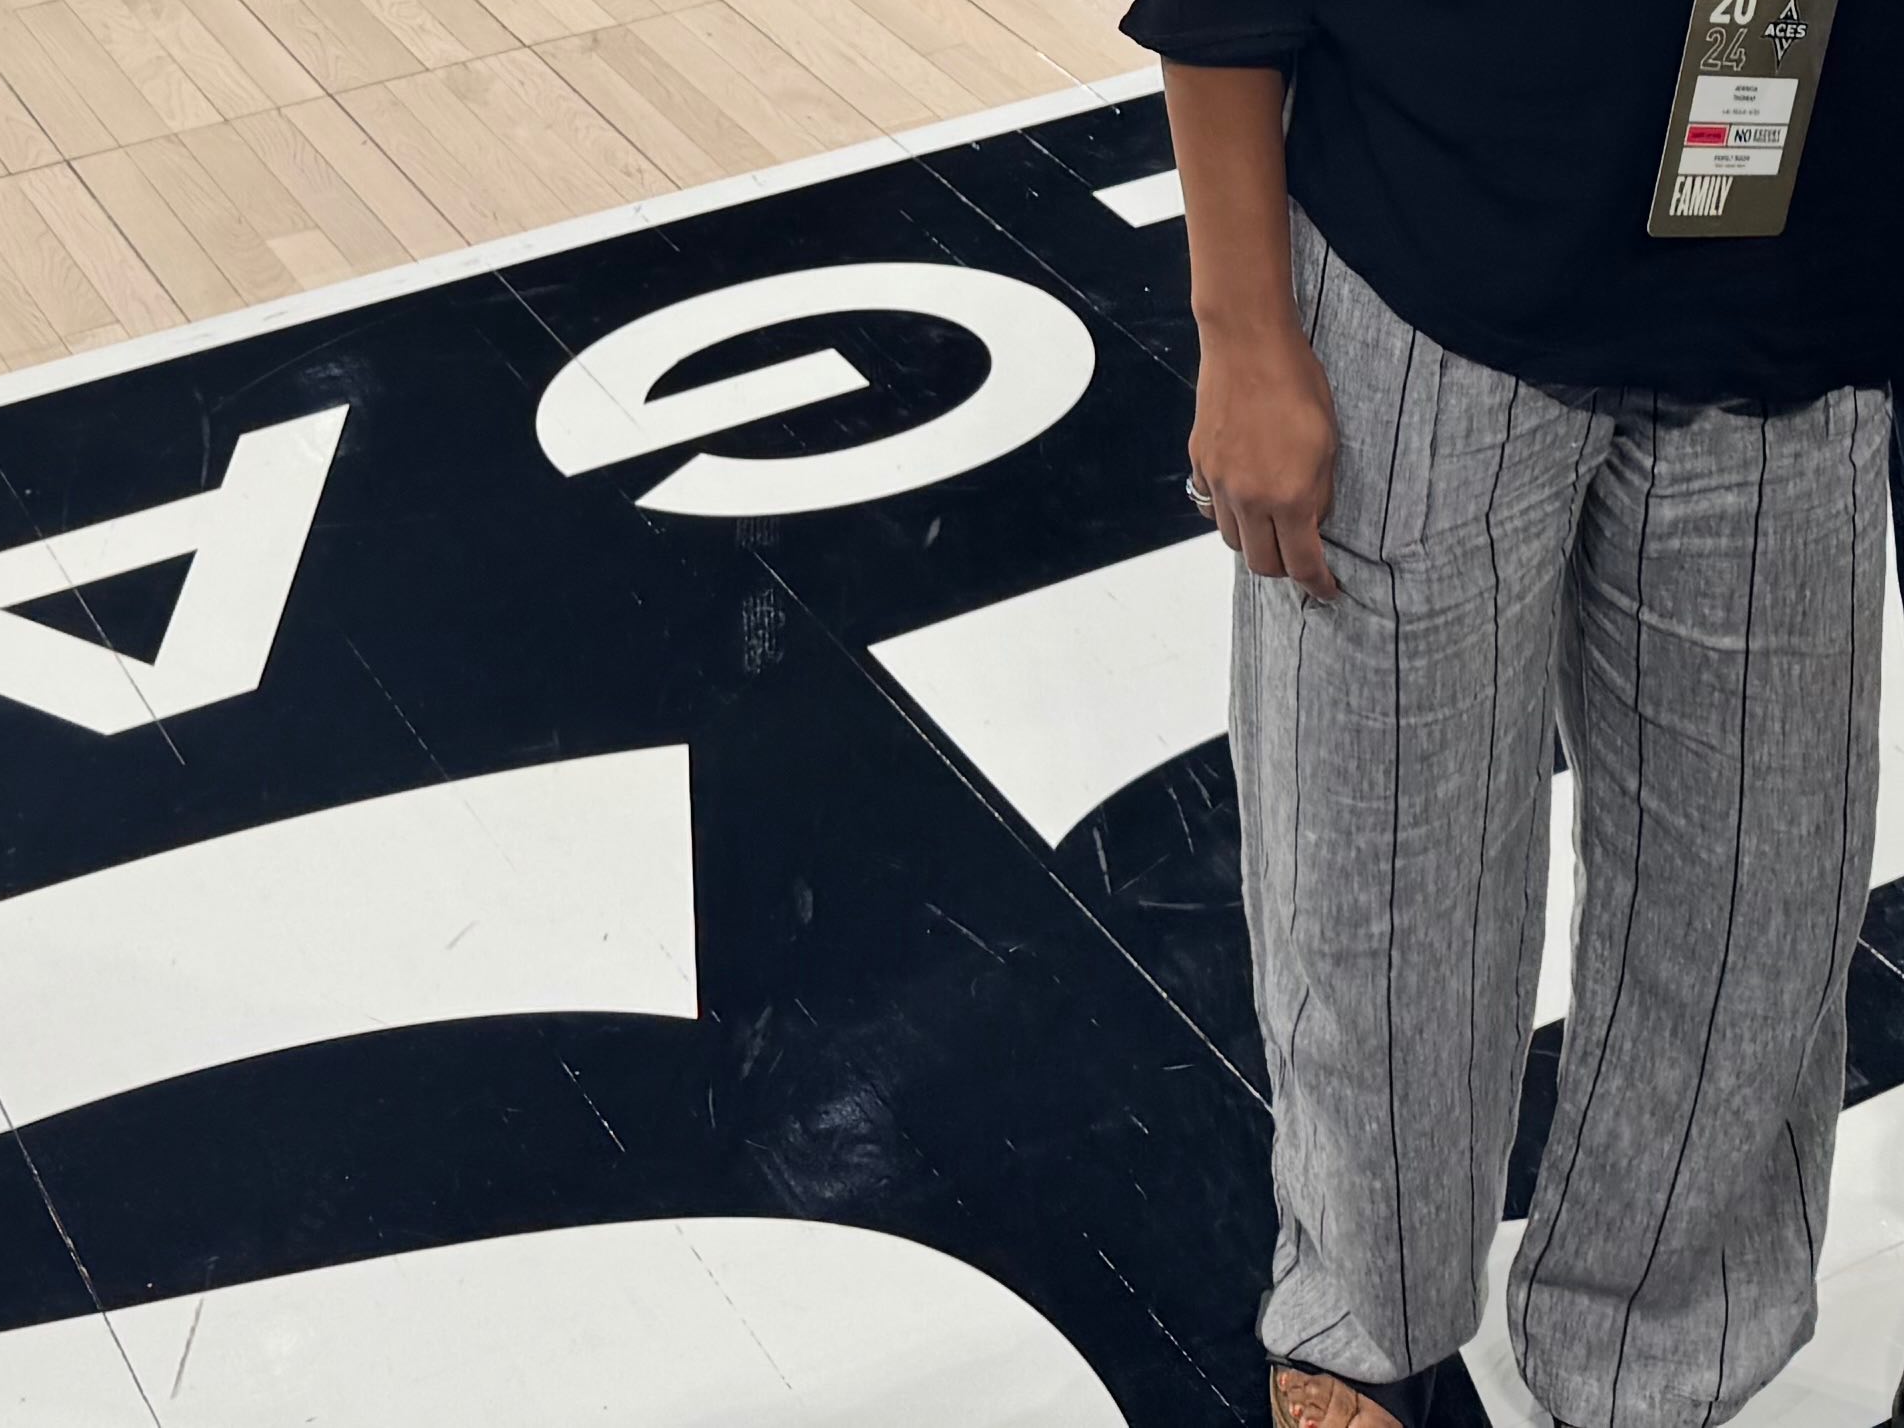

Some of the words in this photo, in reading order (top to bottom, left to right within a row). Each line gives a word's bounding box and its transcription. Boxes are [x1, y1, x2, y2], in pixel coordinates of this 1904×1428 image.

[1763, 23, 1808, 38] ACES
[1700, 27, 1748, 71] 24
[1734, 128, 1752, 143] NO
[1669, 176, 1733, 216] FAMILY
